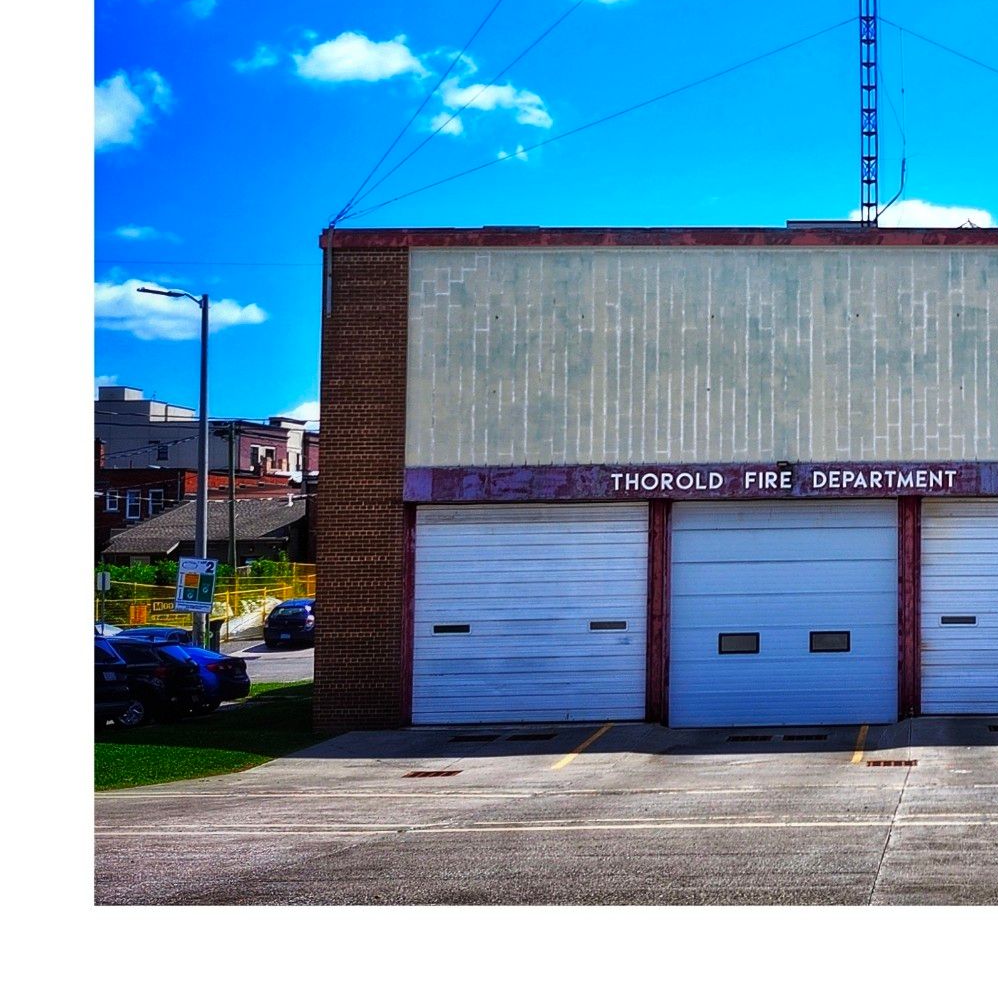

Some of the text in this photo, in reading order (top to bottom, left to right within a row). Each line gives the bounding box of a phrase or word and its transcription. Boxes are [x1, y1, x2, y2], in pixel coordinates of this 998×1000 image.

[610, 470, 958, 491] THOROLD FIRE DEPARTMENT
[205, 561, 215, 573] 2
